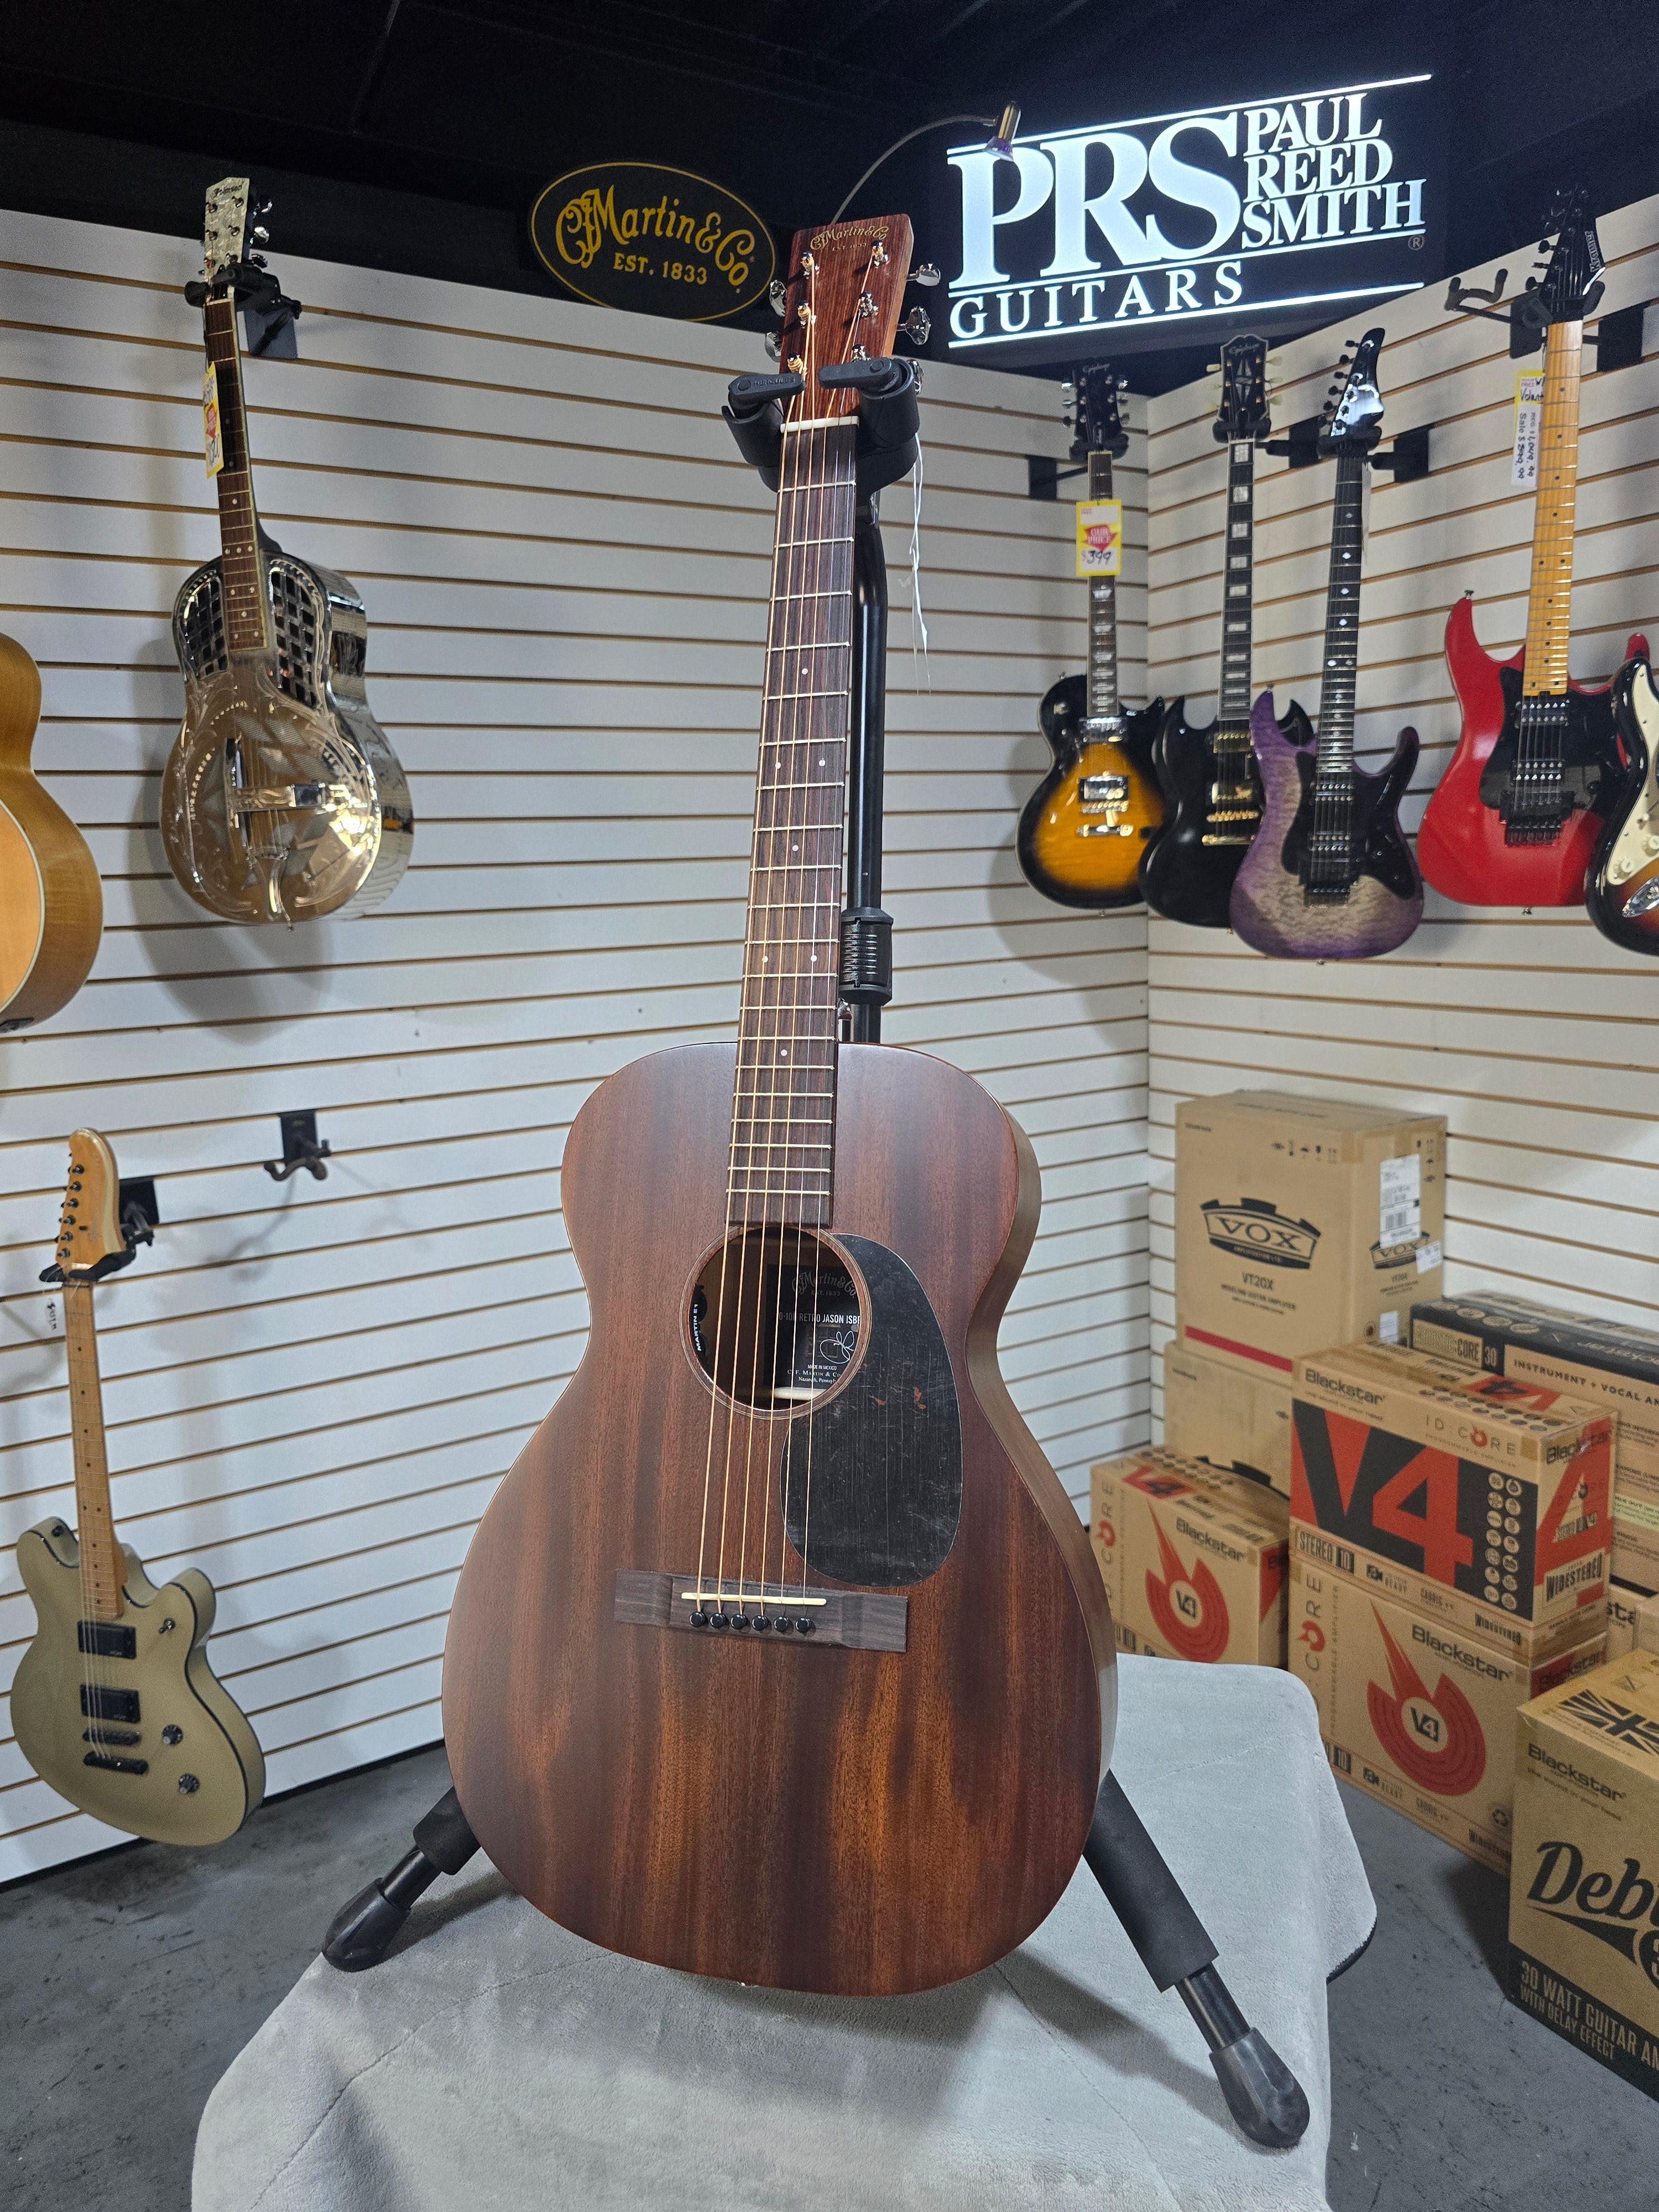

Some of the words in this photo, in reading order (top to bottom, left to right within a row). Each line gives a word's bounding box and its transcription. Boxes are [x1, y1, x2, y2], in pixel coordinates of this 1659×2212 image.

[1244, 92, 1382, 158] PAUL
[1244, 139, 1393, 203] REED
[947, 112, 1241, 288] PRS
[1241, 179, 1427, 250] SMITH
[613, 253, 654, 276] EST.
[661, 262, 708, 284] 1833
[950, 260, 1243, 340] GUITARS
[1088, 535, 1111, 544] PRICE
[1215, 1217, 1301, 1252] VOX
[1242, 1272, 1274, 1291] VT20X
[693, 1316, 702, 1352] MARTIN
[822, 1314, 844, 1323] JASON
[1484, 1346, 1498, 1367] 30
[1305, 1368, 1383, 1405] Blackstar
[1514, 1359, 1586, 1386] INSTRUMENT
[1601, 1383, 1641, 1402] VOCAL
[1547, 1430, 1612, 1464] Blactar
[1176, 1517, 1245, 1562] Blackstar
[1300, 1531, 1333, 1564] STEREO
[1412, 1624, 1510, 1681] Blackstar
[1411, 1707, 1438, 1741] V4
[1528, 1743, 1623, 1801] Blackstar
[1527, 1841, 1659, 1927] Deb
[1521, 1960, 1538, 1991] 30
[1543, 1974, 1582, 2019] WATT
[1585, 2003, 1637, 2057] GUITAR
[1521, 1984, 1545, 2014] WITH
[1549, 2004, 1578, 2035] DELAY
[1580, 2027, 1615, 2060] EFFECT
